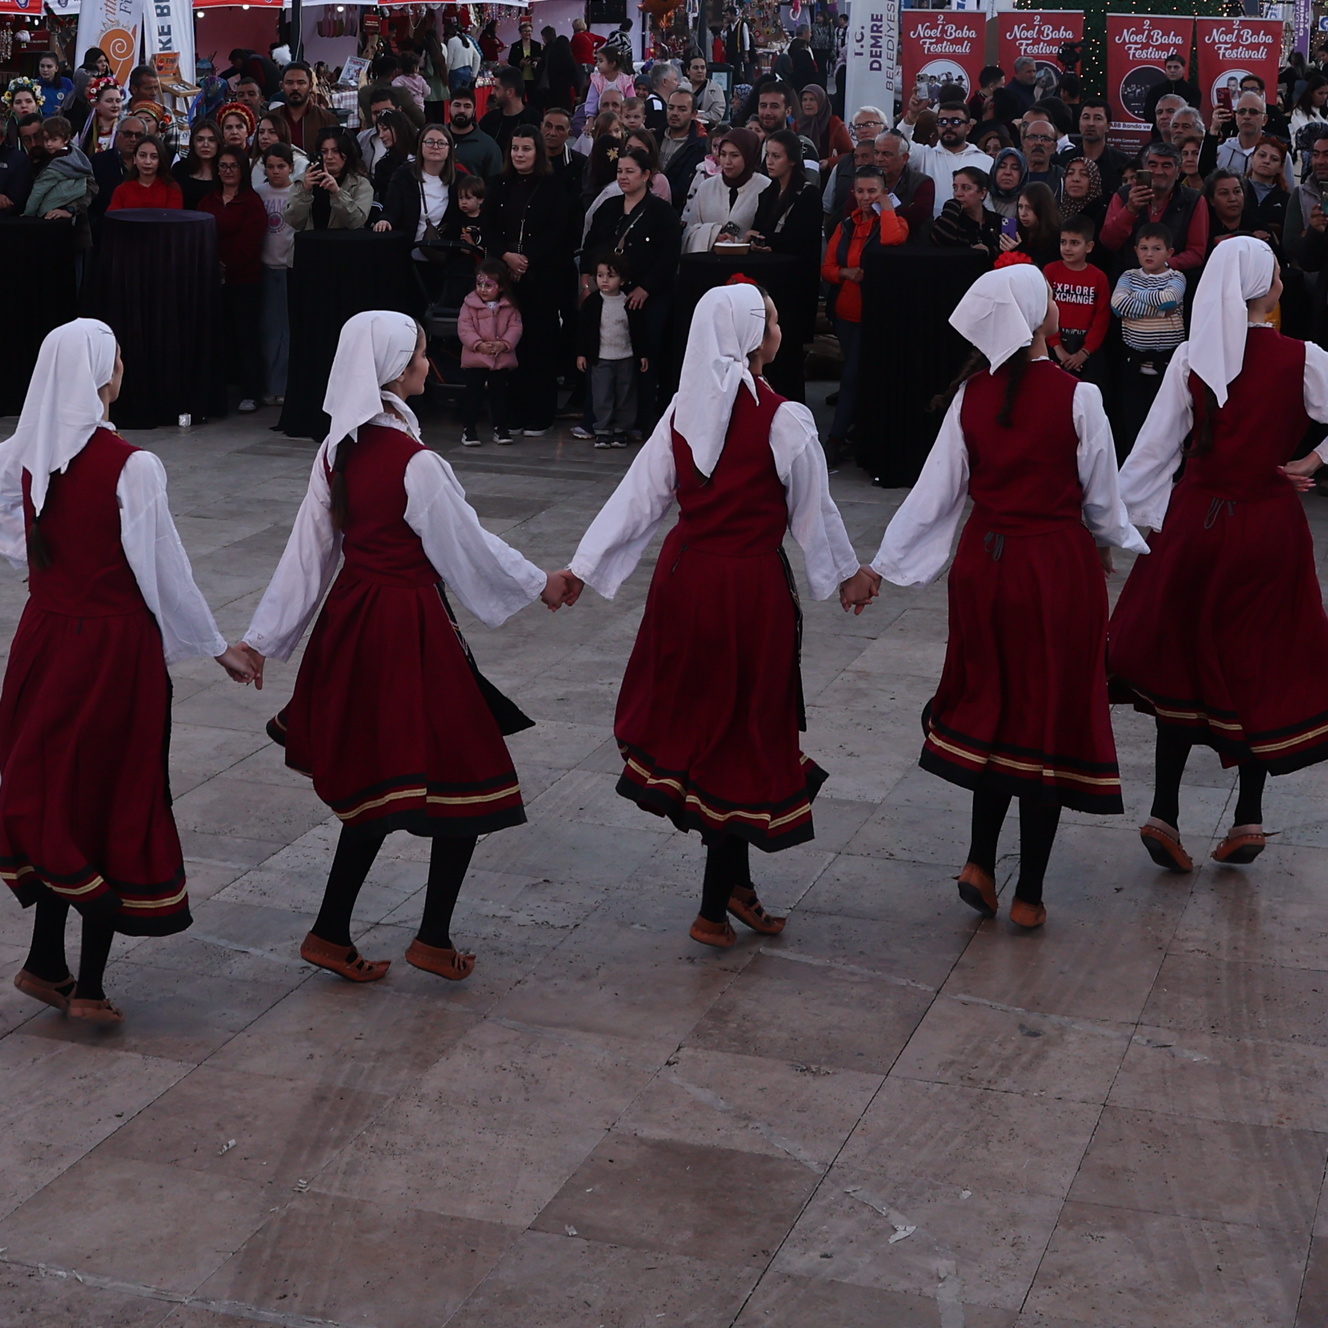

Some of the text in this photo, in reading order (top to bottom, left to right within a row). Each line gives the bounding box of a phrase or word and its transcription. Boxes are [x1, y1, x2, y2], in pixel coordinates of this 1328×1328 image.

[937, 14, 946, 24] 2.
[1033, 15, 1043, 25] 2.
[1143, 19, 1152, 29] 2.
[1232, 19, 1242, 29] 2.
[909, 22, 977, 40] Noel Baba
[1006, 23, 1074, 40] Noel Baba
[1115, 28, 1184, 46] Noel Baba
[1204, 27, 1274, 45] Noel Baba
[853, 25, 865, 57] T.C.
[869, 13, 884, 72] DEMRE
[919, 38, 972, 54] Festivali
[1214, 43, 1268, 60] Festivali
[1054, 291, 1095, 305] XCHANGE
